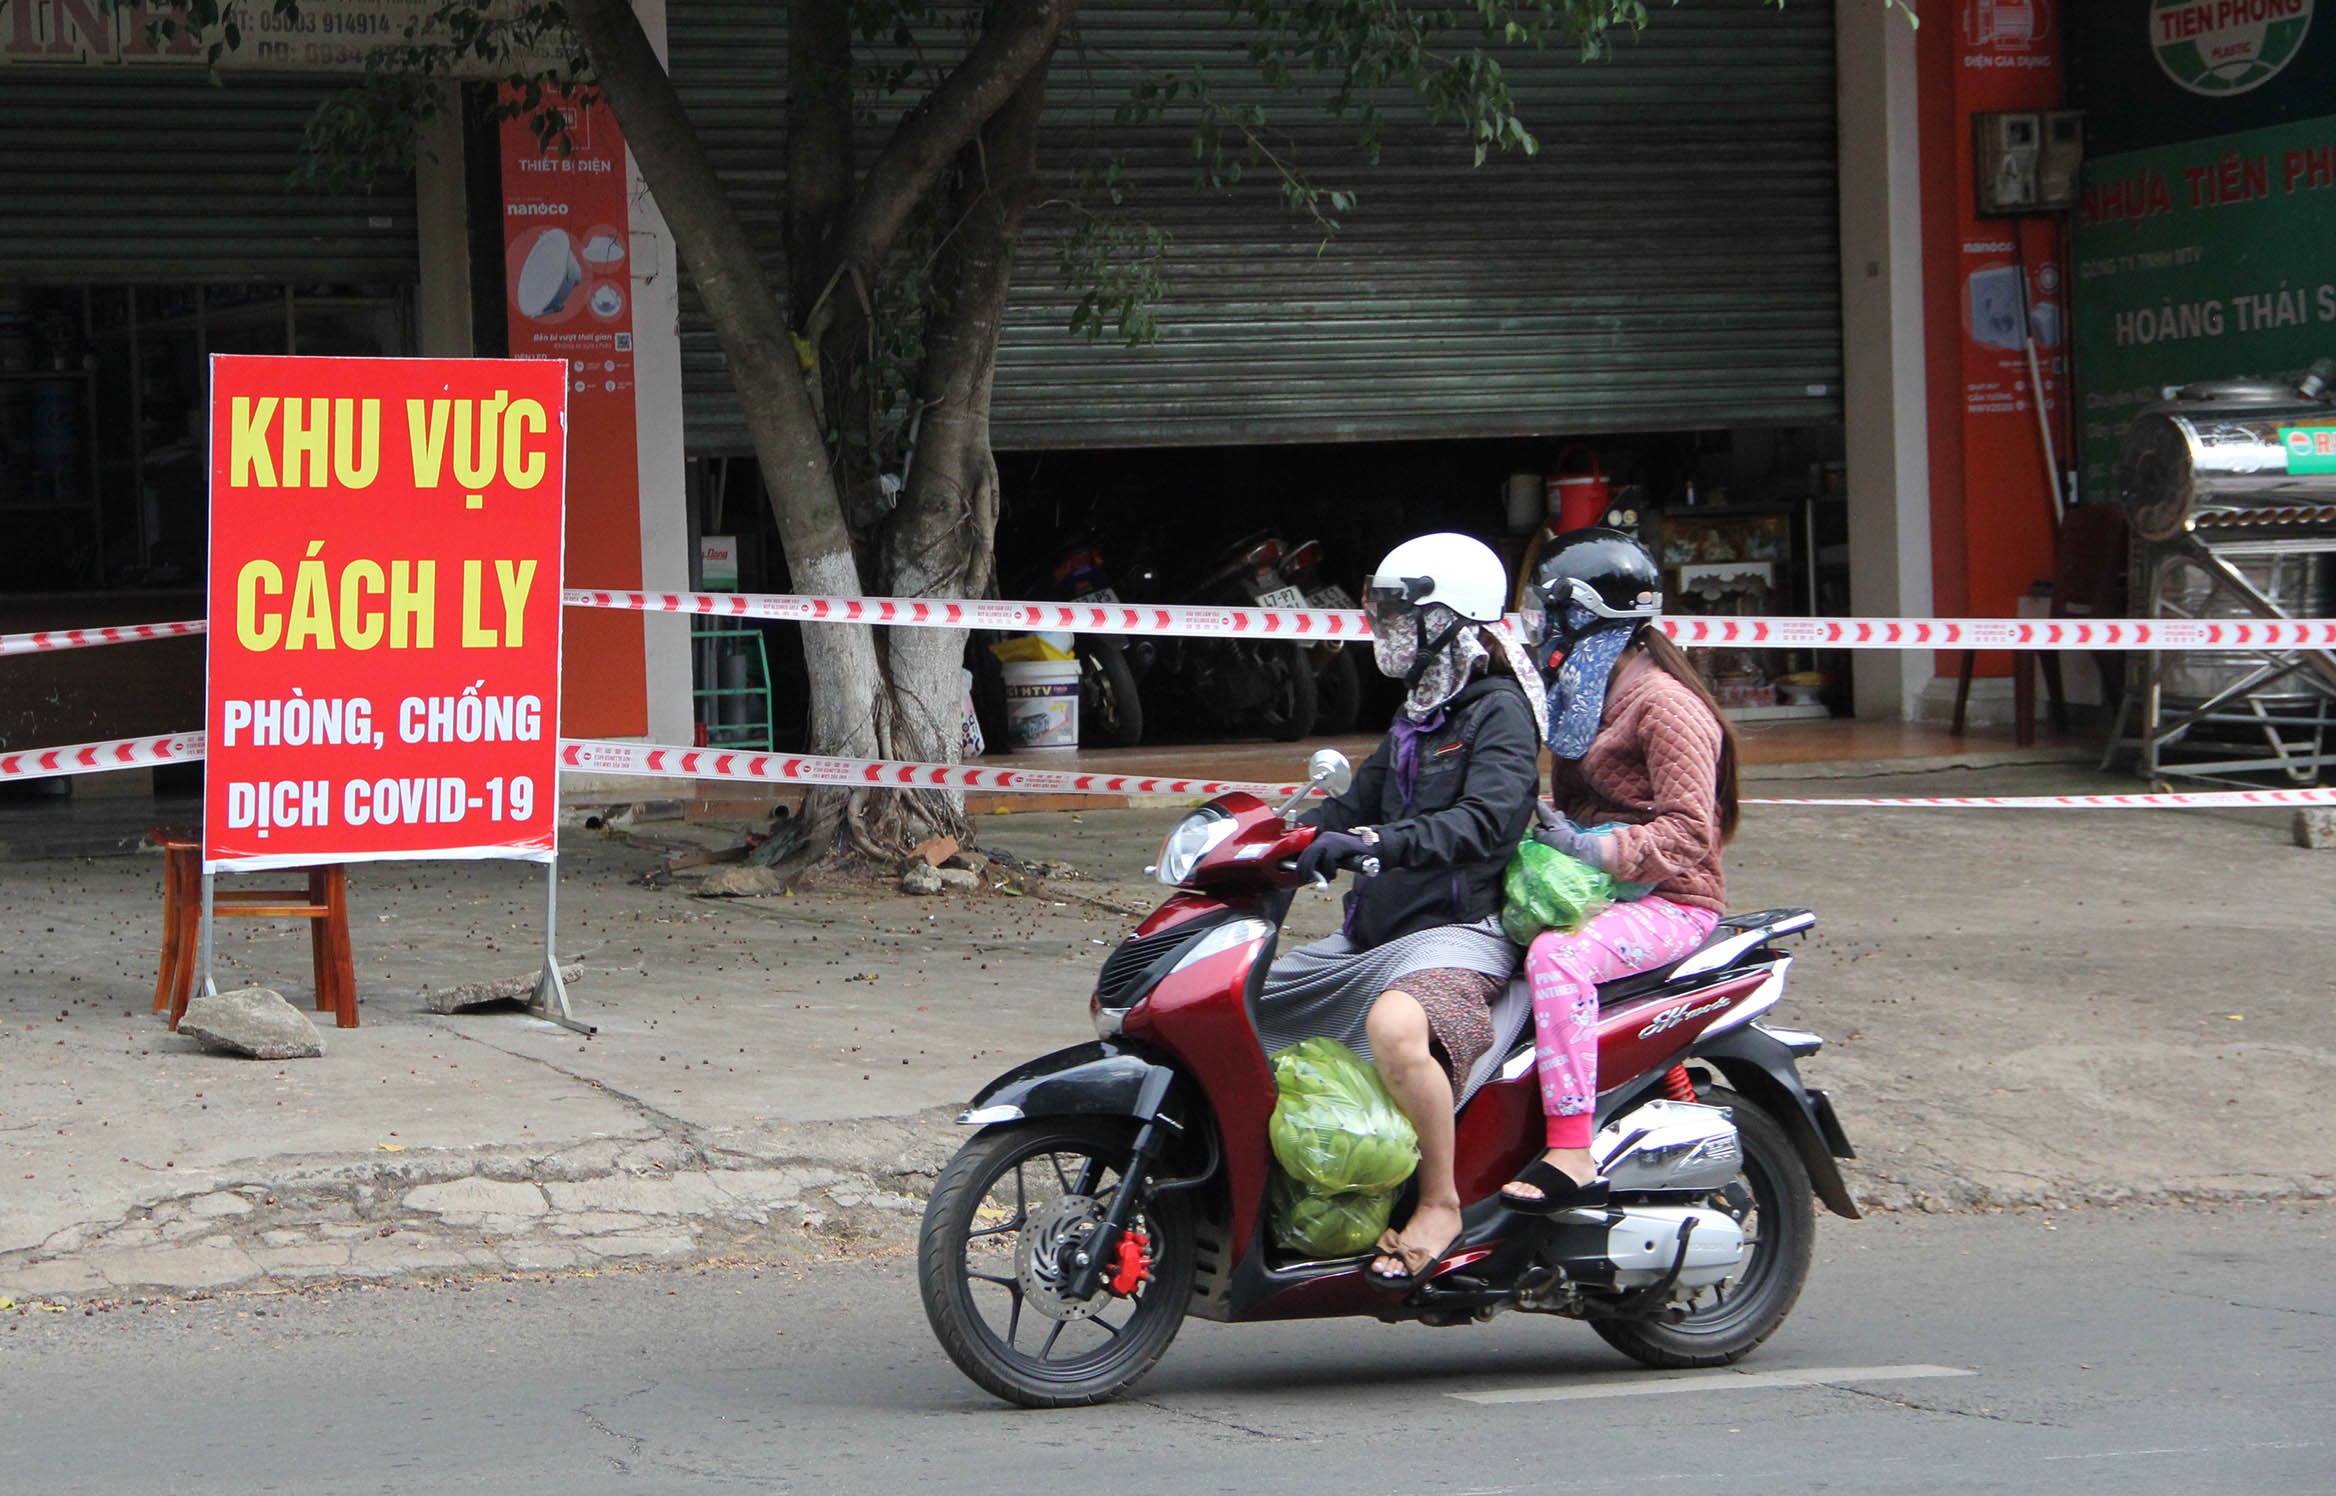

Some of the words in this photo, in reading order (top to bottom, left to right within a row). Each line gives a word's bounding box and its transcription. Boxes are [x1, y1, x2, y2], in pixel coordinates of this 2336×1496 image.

[323, 11, 390, 34] 914914
[1995, 56, 2015, 68] GIA
[2283, 143, 2336, 195] PH
[507, 203, 569, 215] nanoco
[2115, 297, 2224, 347] HOÀNG
[2231, 280, 2307, 332] THÁI
[230, 396, 381, 489] KHU
[407, 389, 547, 509] VỰC
[2314, 431, 2336, 454] R
[236, 540, 436, 652] CÁCH
[462, 559, 538, 649] LY
[223, 687, 383, 750] PHÒNG,
[399, 679, 541, 743] CHỐNG
[1022, 686, 1052, 697] HTV
[228, 779, 330, 838] DỊCH
[344, 776, 534, 826] COVID-19
